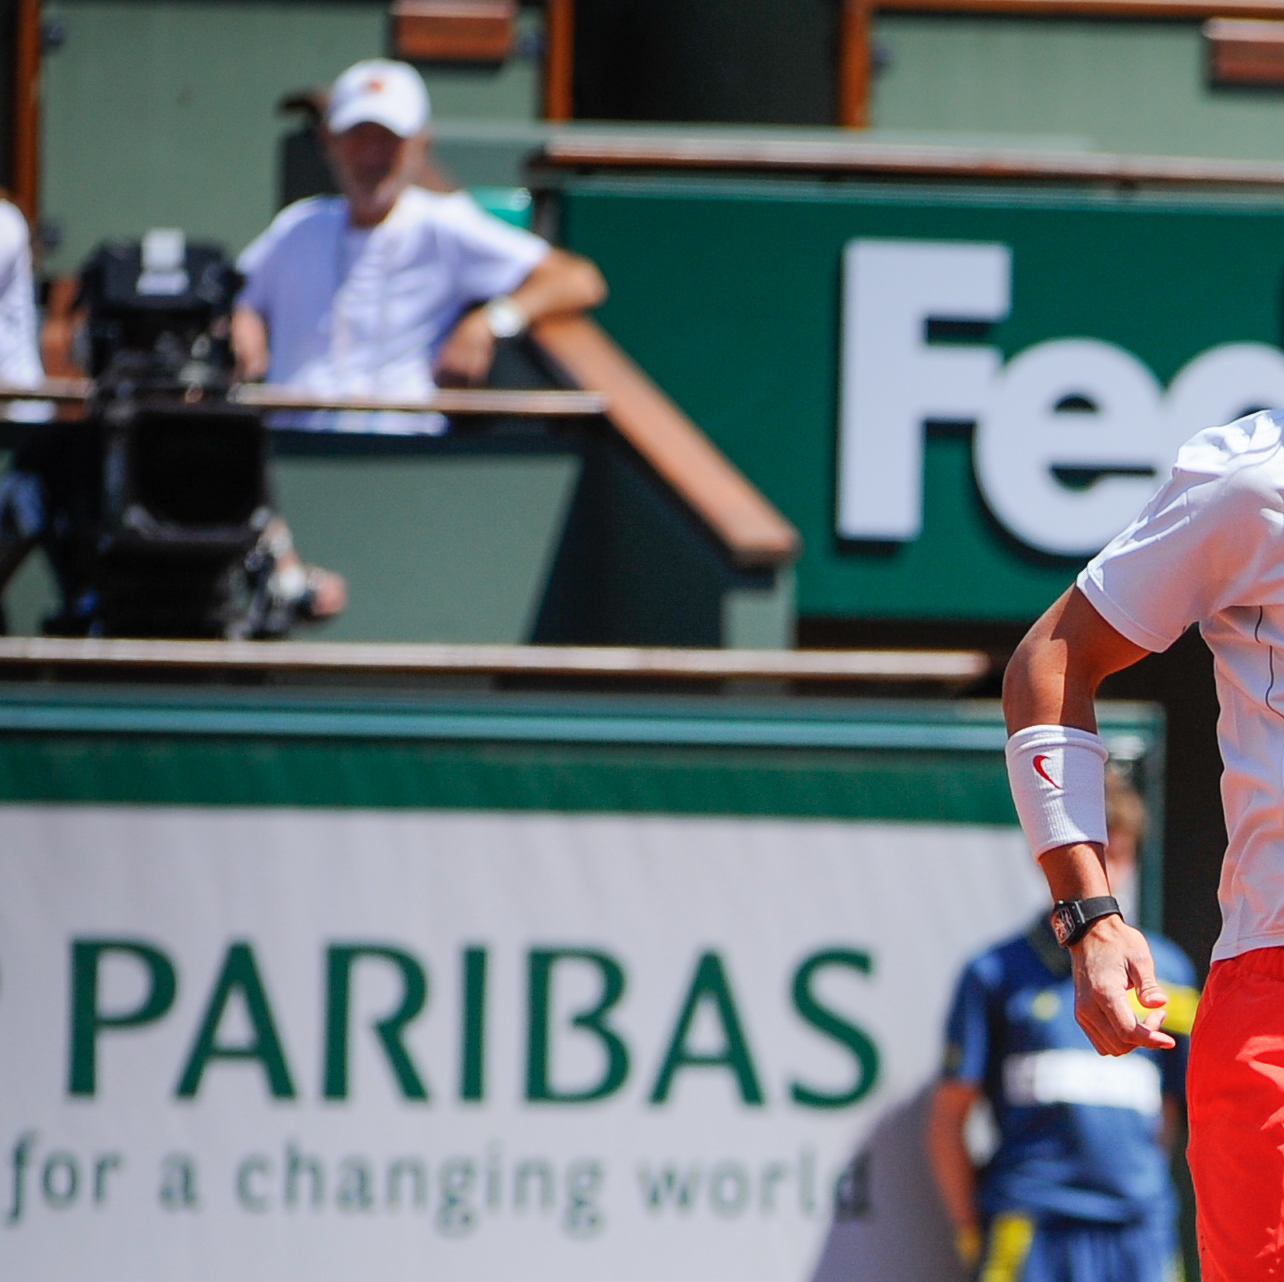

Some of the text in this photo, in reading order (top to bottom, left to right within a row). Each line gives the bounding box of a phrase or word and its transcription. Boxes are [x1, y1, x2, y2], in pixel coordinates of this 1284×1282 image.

[67, 936, 881, 1110] PARIBAS
[7, 1128, 873, 1239] for a changing world
